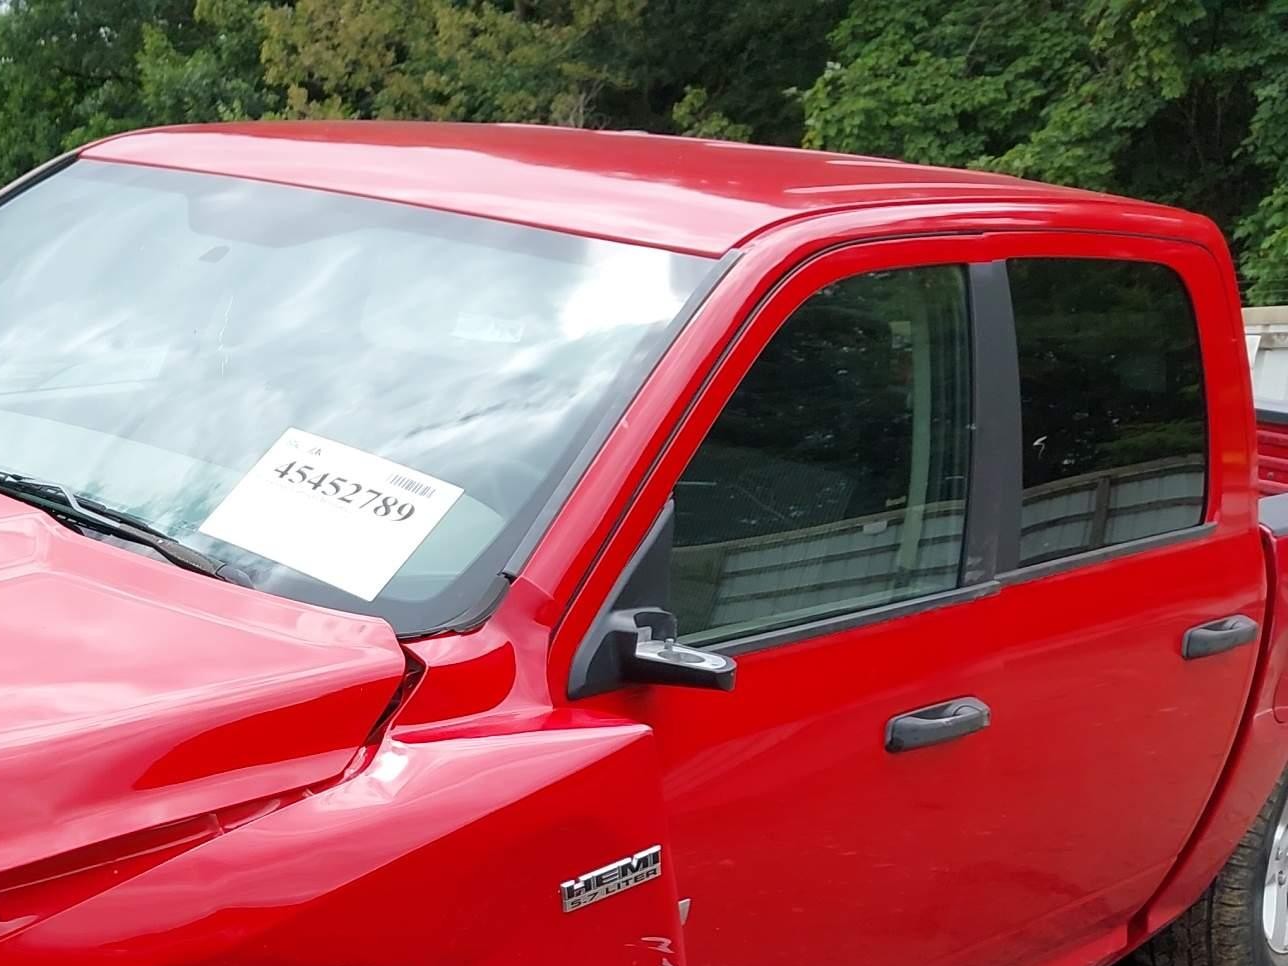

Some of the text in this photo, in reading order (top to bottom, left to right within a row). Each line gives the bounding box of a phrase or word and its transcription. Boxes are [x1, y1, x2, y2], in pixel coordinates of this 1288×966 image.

[273, 459, 416, 522] 45452789
[560, 844, 662, 901] HEMI
[570, 868, 658, 909] 5.7 LITER
